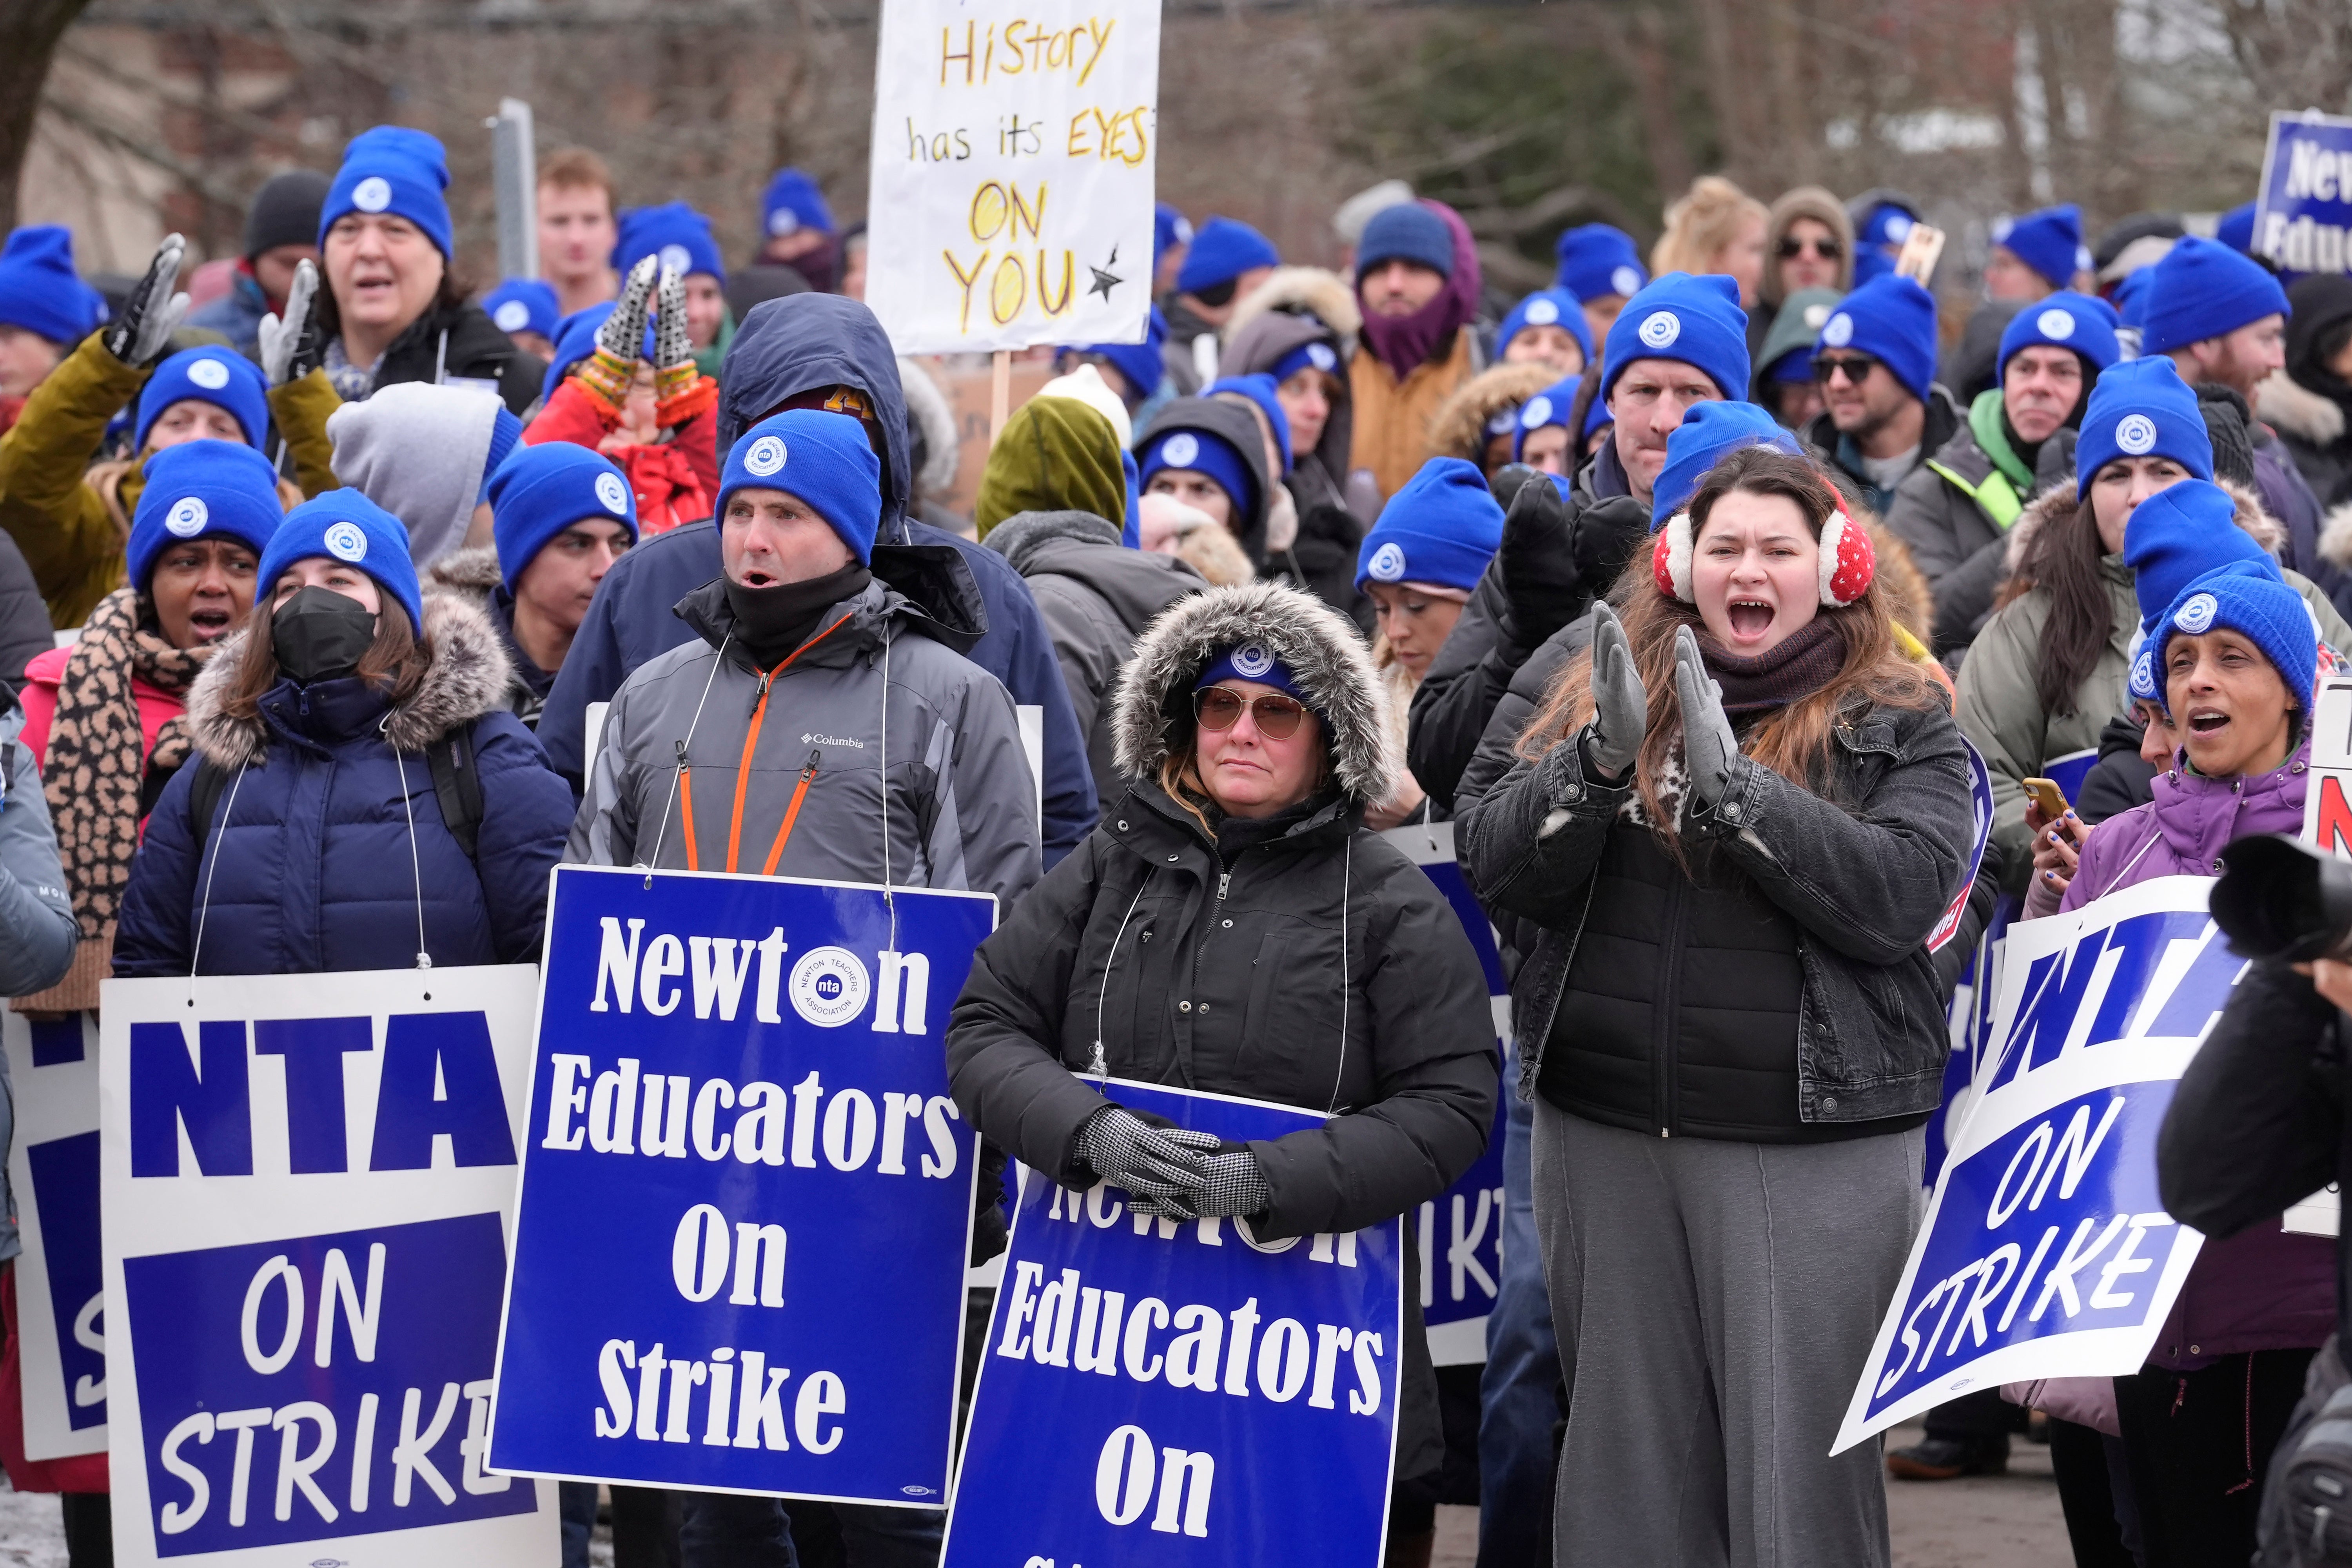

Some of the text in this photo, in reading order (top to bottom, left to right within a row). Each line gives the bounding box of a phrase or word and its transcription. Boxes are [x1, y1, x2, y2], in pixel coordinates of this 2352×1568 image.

[907, 105, 1148, 169] has its EYES
[969, 178, 1049, 245] ON
[2262, 211, 2352, 273] Edu
[942, 248, 1076, 334] YOU
[751, 461, 777, 469] ASSOCIATION
[767, 441, 780, 458] TEACHERS
[1237, 658, 1265, 670] ASSOCIATION
[813, 734, 864, 749] Columbia
[801, 959, 857, 992] NEWTON TEACHERS
[805, 997, 852, 1015] ASSOCIATION
[818, 980, 839, 993] nta
[131, 1010, 518, 1178] NTA
[542, 1052, 961, 1180] Educators
[1987, 1096, 2125, 1230] ON
[672, 1203, 788, 1308] On
[240, 1242, 386, 1375] ON
[997, 1260, 1385, 1416] Educators
[1878, 1212, 2176, 1399] STRIKE
[595, 1339, 847, 1455] Strike
[160, 1379, 511, 1536] STRIKE
[1095, 1424, 1216, 1538] On
